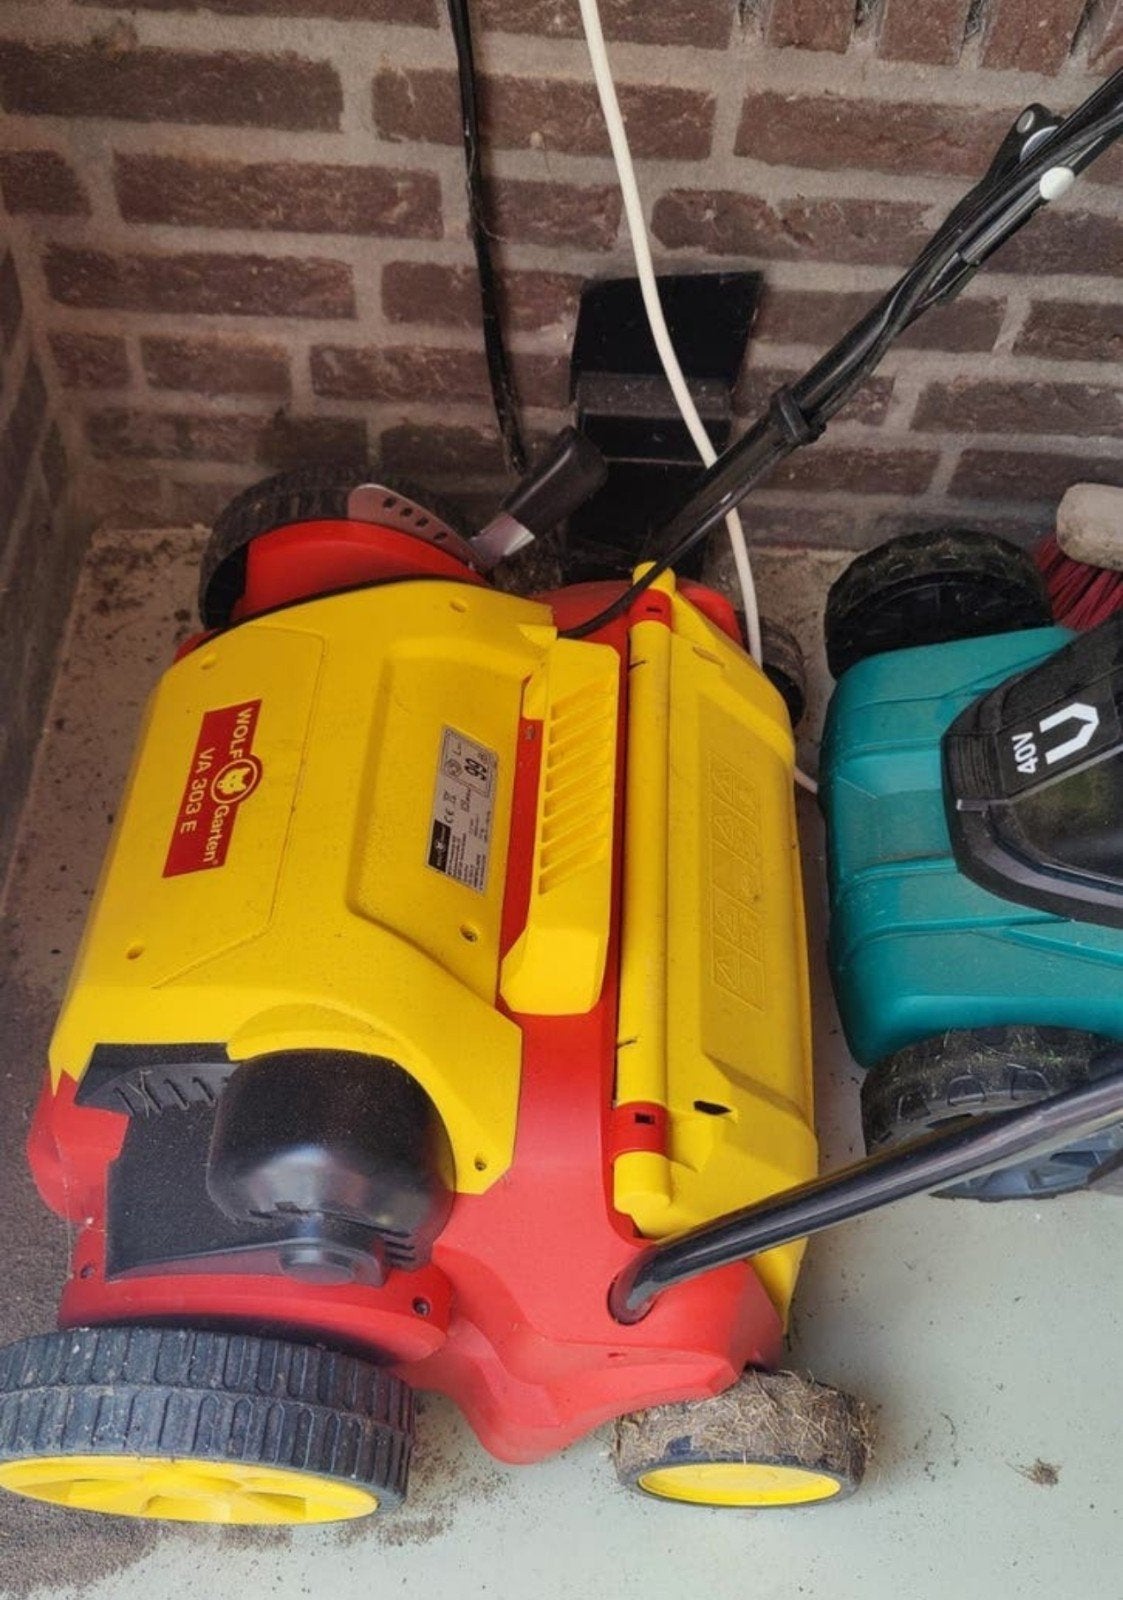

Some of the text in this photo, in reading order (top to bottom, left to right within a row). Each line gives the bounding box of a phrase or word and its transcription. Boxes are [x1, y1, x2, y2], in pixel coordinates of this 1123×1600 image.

[229, 707, 254, 760] WOLF
[1011, 731, 1039, 774] 40V
[180, 746, 216, 834] VA 303 E
